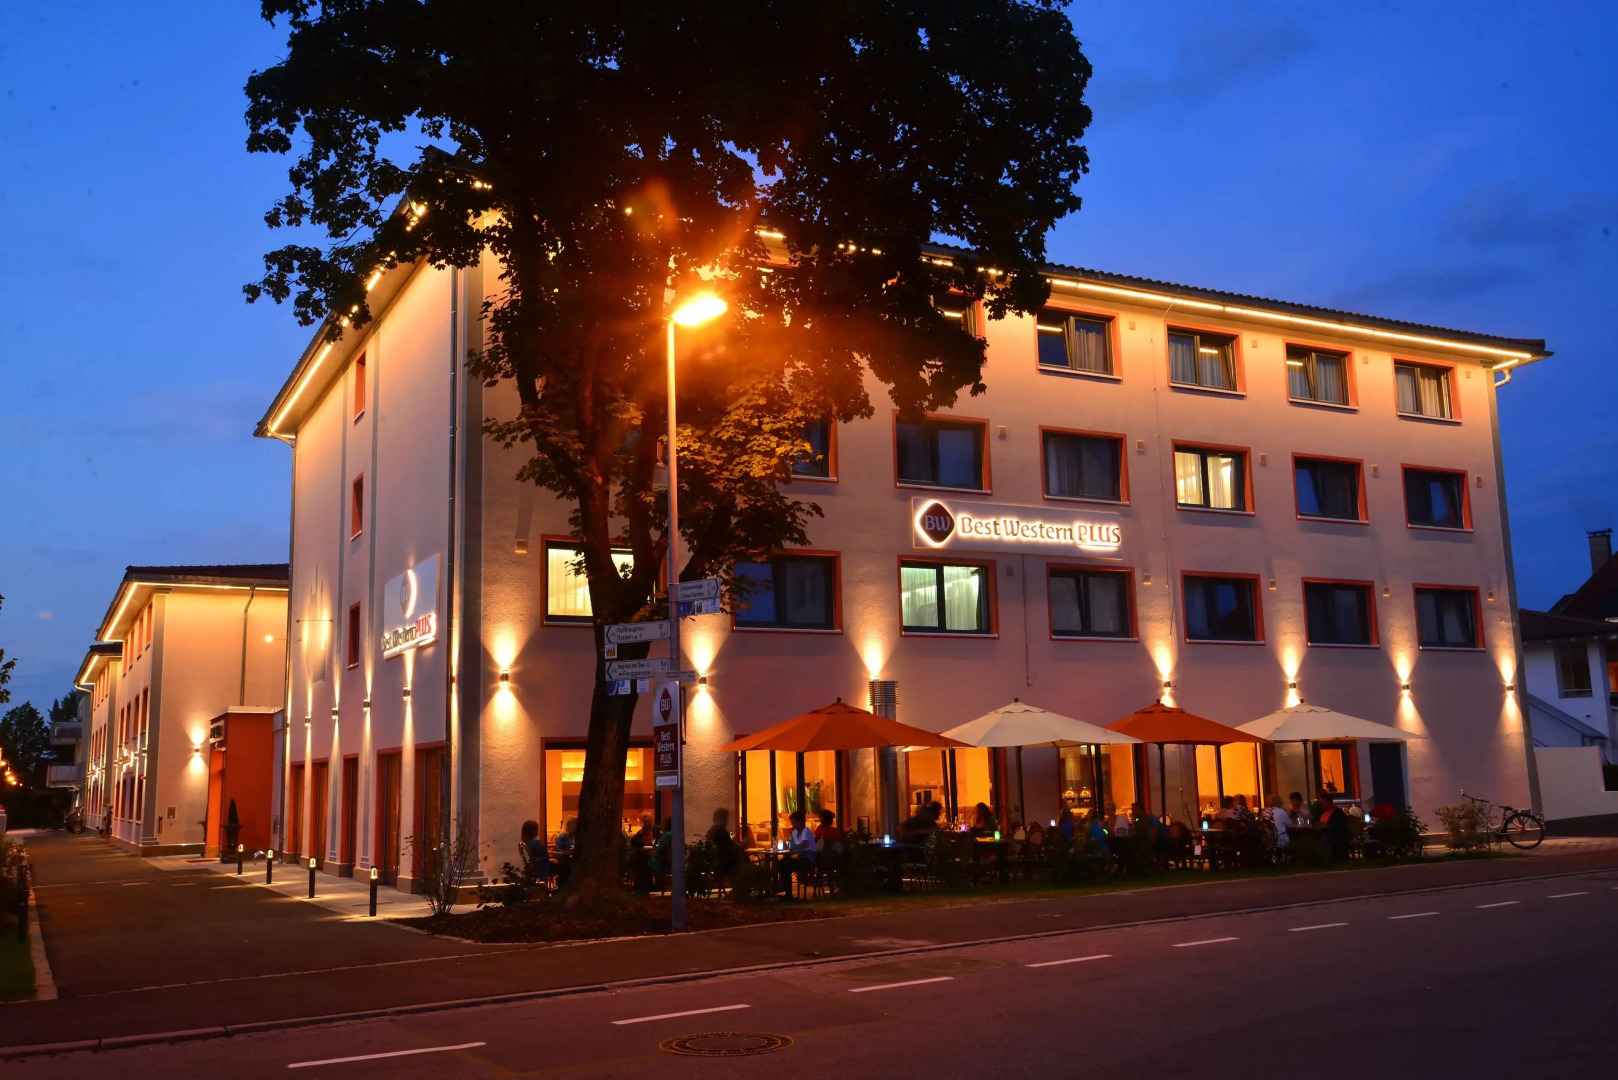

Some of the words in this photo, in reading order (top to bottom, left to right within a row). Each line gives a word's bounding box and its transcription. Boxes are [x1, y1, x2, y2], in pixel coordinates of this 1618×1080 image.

[924, 514, 951, 532] BW
[961, 516, 1001, 536] Best
[1003, 518, 1074, 541] Western
[1078, 524, 1121, 544] PLUS
[660, 698, 671, 712] BW
[660, 730, 671, 742] Best
[657, 741, 675, 752] Western
[660, 752, 672, 764] PLUS
